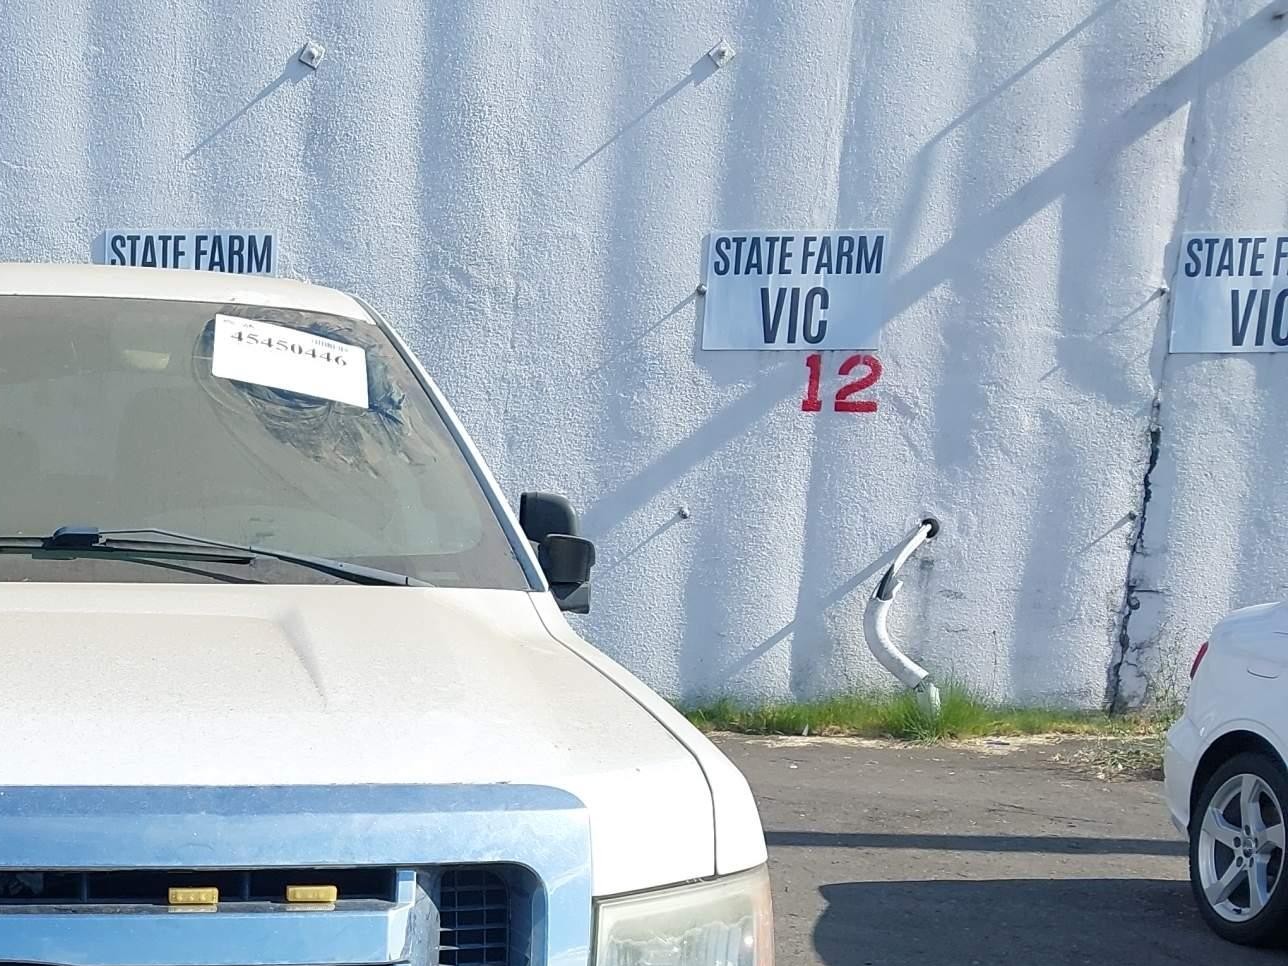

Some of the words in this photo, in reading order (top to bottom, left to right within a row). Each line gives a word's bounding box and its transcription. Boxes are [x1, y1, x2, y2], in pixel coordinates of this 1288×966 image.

[194, 235, 272, 274] FARM
[713, 236, 795, 276] STATE
[801, 235, 884, 275] FARM
[1184, 237, 1267, 278] STATE
[760, 286, 829, 345] VIC
[230, 330, 348, 368] 45450446
[801, 354, 883, 412] 12
